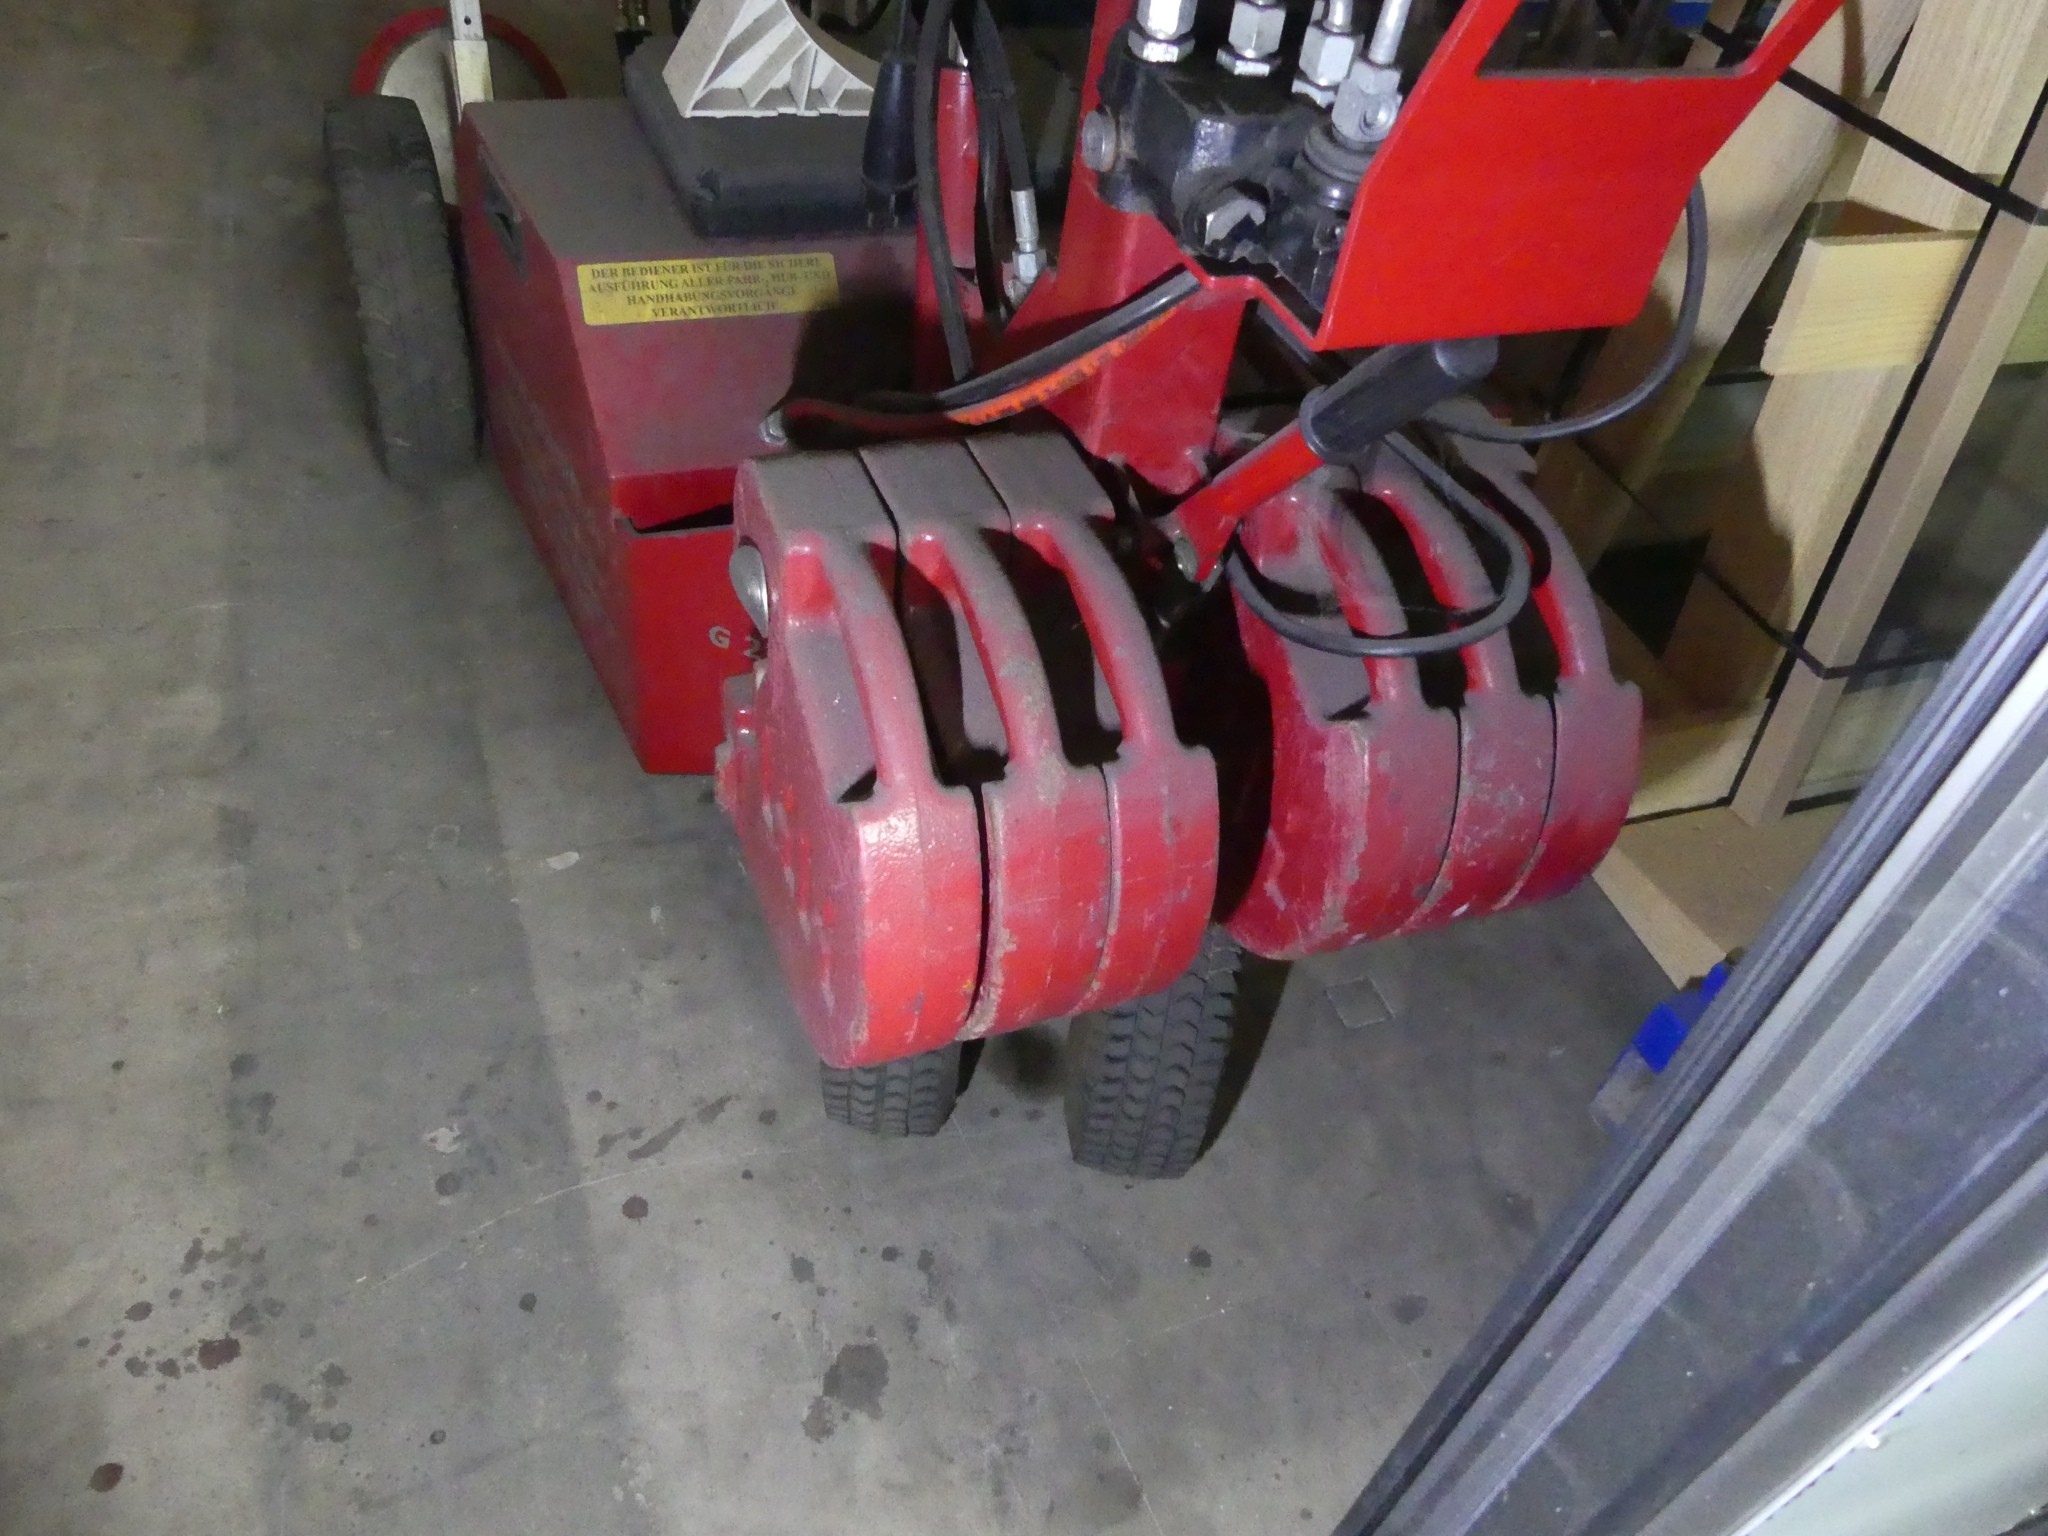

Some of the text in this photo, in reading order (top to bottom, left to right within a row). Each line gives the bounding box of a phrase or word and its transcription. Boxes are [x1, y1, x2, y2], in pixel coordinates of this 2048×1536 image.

[590, 267, 618, 278] DER
[620, 263, 689, 277] BEDIENER
[691, 262, 711, 273] IST
[709, 625, 731, 649] G
